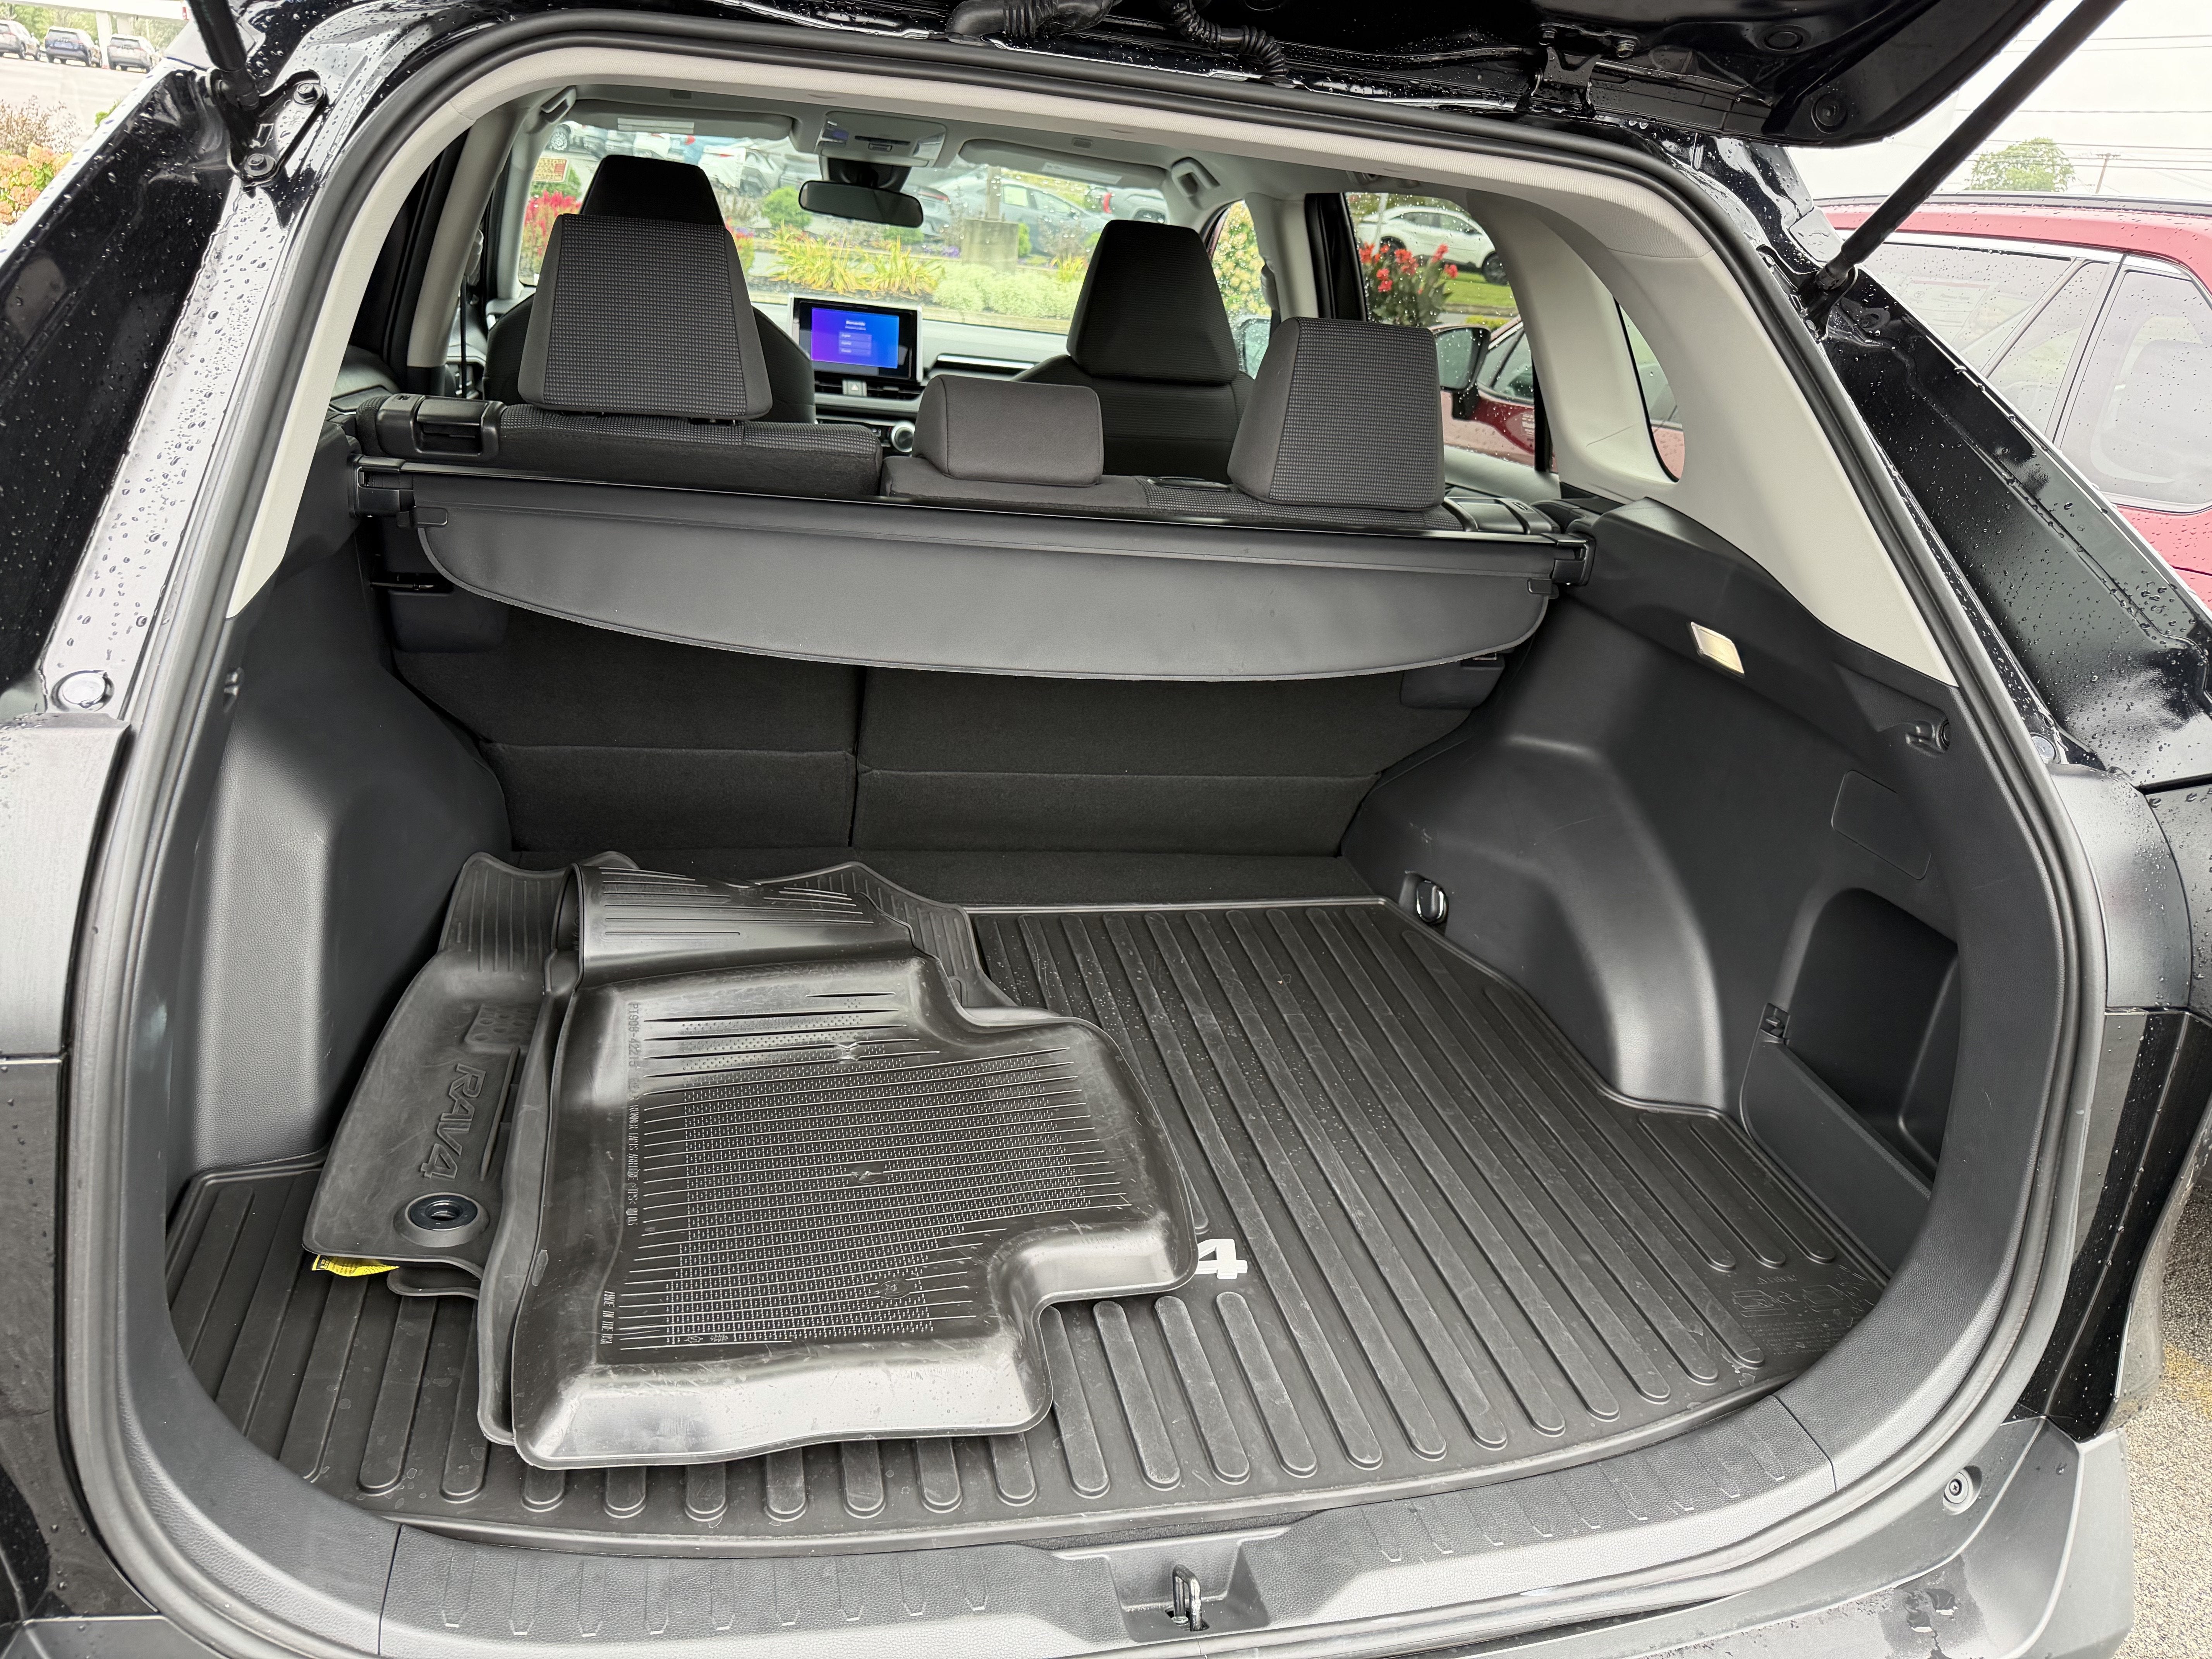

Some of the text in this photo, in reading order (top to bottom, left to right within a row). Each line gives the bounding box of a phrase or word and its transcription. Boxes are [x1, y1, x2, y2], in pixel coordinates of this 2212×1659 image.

[419, 1063, 488, 1180] RAV4
[603, 1290, 616, 1307] MADE
[601, 1321, 614, 1332] THE
[600, 1333, 613, 1344] USA
